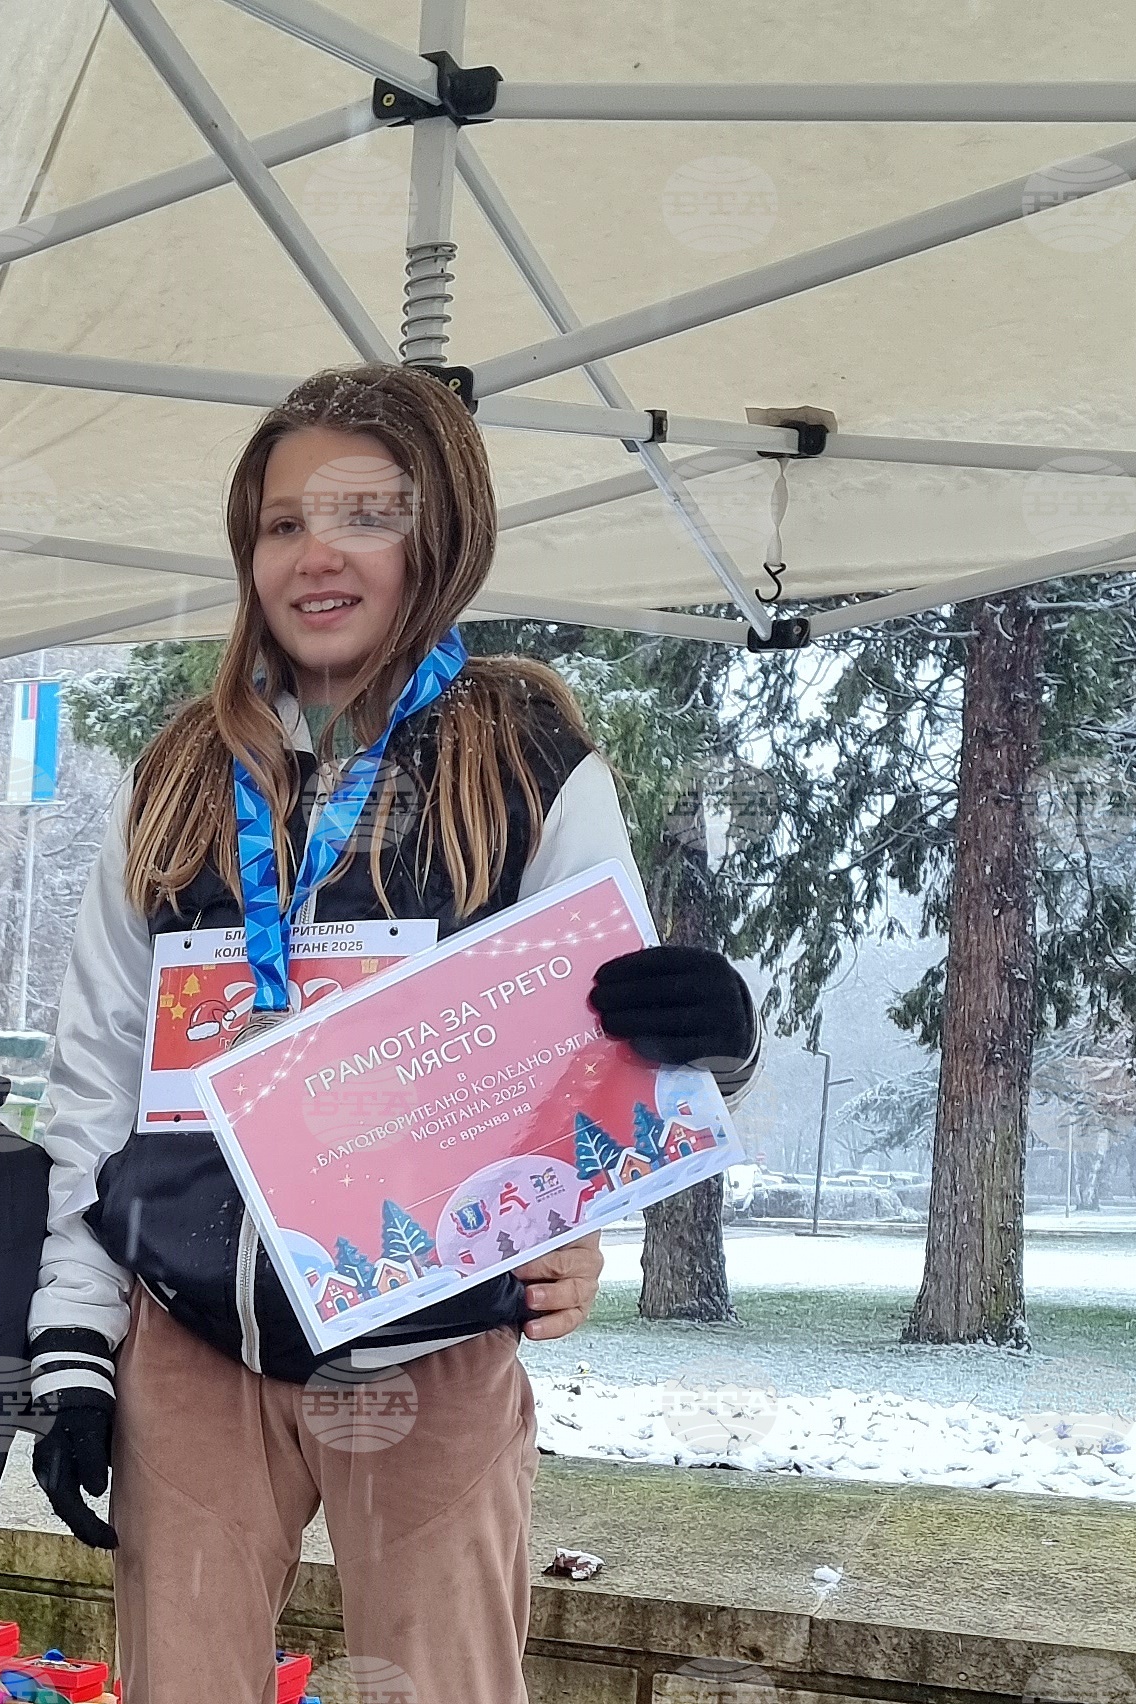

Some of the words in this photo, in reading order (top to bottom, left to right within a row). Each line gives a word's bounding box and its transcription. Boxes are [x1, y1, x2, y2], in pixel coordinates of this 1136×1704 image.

[331, 940, 364, 952] 2025
[303, 1020, 440, 1098] ГРАМОТА
[439, 1000, 481, 1034] ЗА
[478, 955, 573, 1012] ТРЕТО
[394, 1024, 498, 1086] МЯСТО
[316, 1088, 470, 1168] БЛАГОТВОРИТЕЛНО
[472, 1048, 554, 1096] КОЛЕДНО
[554, 1026, 607, 1057] БЯГАН
[456, 1071, 467, 1082] в
[410, 1099, 491, 1143] МОНТАНА
[493, 1081, 526, 1107] 2025
[439, 1135, 457, 1150] се
[459, 1111, 510, 1142] връчва
[511, 1101, 532, 1118] на
